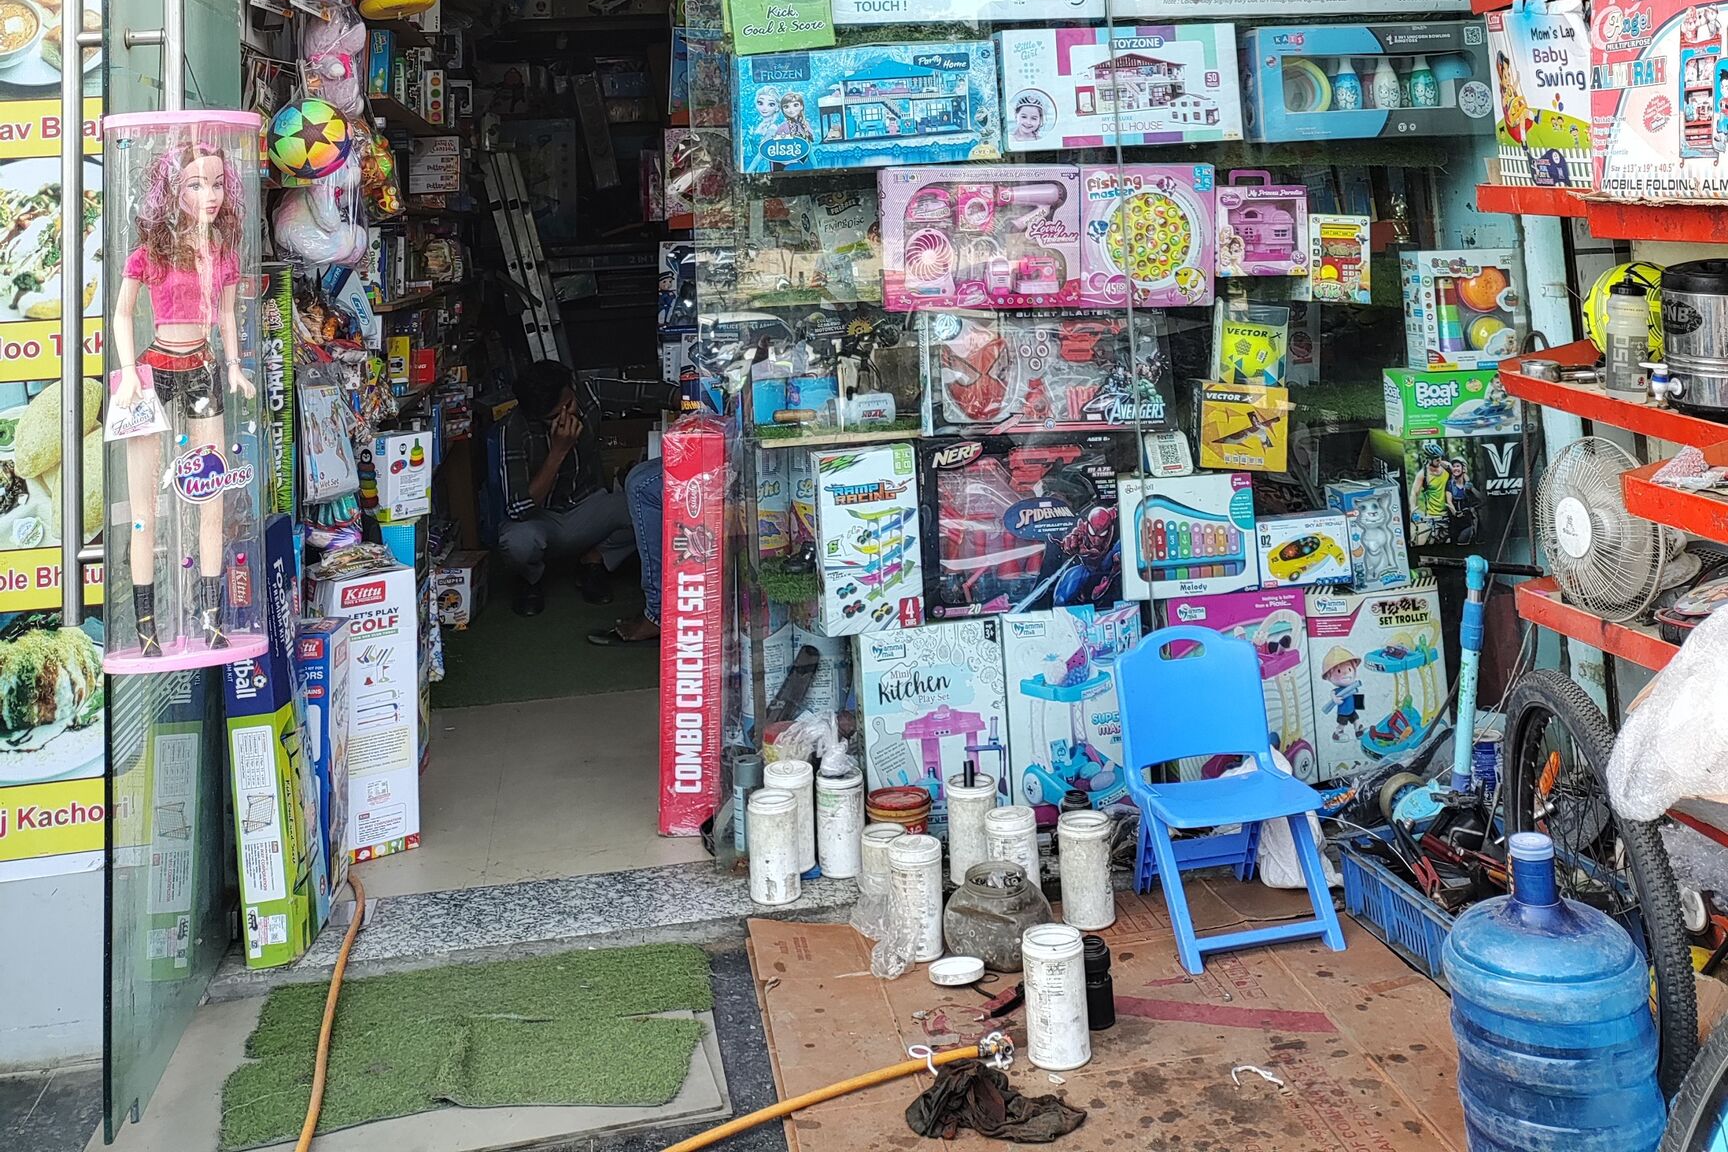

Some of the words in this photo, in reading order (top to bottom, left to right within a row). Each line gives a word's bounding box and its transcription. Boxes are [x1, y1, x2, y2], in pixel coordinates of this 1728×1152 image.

[854, 0, 900, 12] TOUCH
[743, 20, 775, 36] Goal
[777, 21, 787, 32] &
[789, 18, 825, 32] Score
[1607, 6, 1653, 41] Angel
[1530, 25, 1558, 42] Mom's
[1560, 24, 1575, 42] Lap
[1113, 37, 1161, 49] TOYZONE
[1606, 39, 1651, 52] MULTIPURPOSE
[917, 55, 942, 66] Party
[943, 57, 967, 69] Home
[1533, 46, 1569, 66] Baby
[760, 68, 803, 81] FROZEN
[1535, 67, 1587, 91] Swing
[1591, 56, 1667, 90] ALMIRAH
[1130, 120, 1164, 132] HOUSE
[767, 140, 802, 156] elsa's
[1603, 178, 1643, 191] MOBILE
[1105, 283, 1117, 295] 45
[1226, 327, 1269, 338] VECTOR
[1269, 331, 1283, 339] X
[1612, 335, 1630, 374] 750
[267, 338, 284, 412] CHAMPS
[1205, 392, 1241, 402] VECTOR
[1241, 394, 1253, 402] X
[1415, 380, 1459, 399] Boat
[1416, 397, 1452, 409] Speed
[932, 444, 981, 469] NERF
[174, 456, 202, 477] iss
[185, 464, 253, 495] Universe
[1486, 477, 1523, 490] VIVA
[834, 482, 880, 497] RAMP
[834, 491, 897, 506] RACING
[1015, 505, 1075, 529] SPIDER-MAN
[1260, 534, 1272, 546] 02
[345, 587, 382, 601] Kittu
[677, 571, 705, 616] SET
[1179, 582, 1208, 593] Melody
[272, 556, 296, 659] Football
[375, 607, 400, 616] PLAY
[905, 598, 915, 619] 4
[967, 604, 982, 615] 20
[350, 615, 399, 635] GOLF
[1379, 616, 1393, 626] SET
[1395, 612, 1429, 625] TROLLEY
[676, 619, 704, 709] CRICKET
[890, 669, 909, 680] Mini
[878, 670, 951, 705] Kitchen
[918, 693, 936, 704] Play
[938, 692, 950, 701] Set
[675, 711, 703, 794] COMBO
